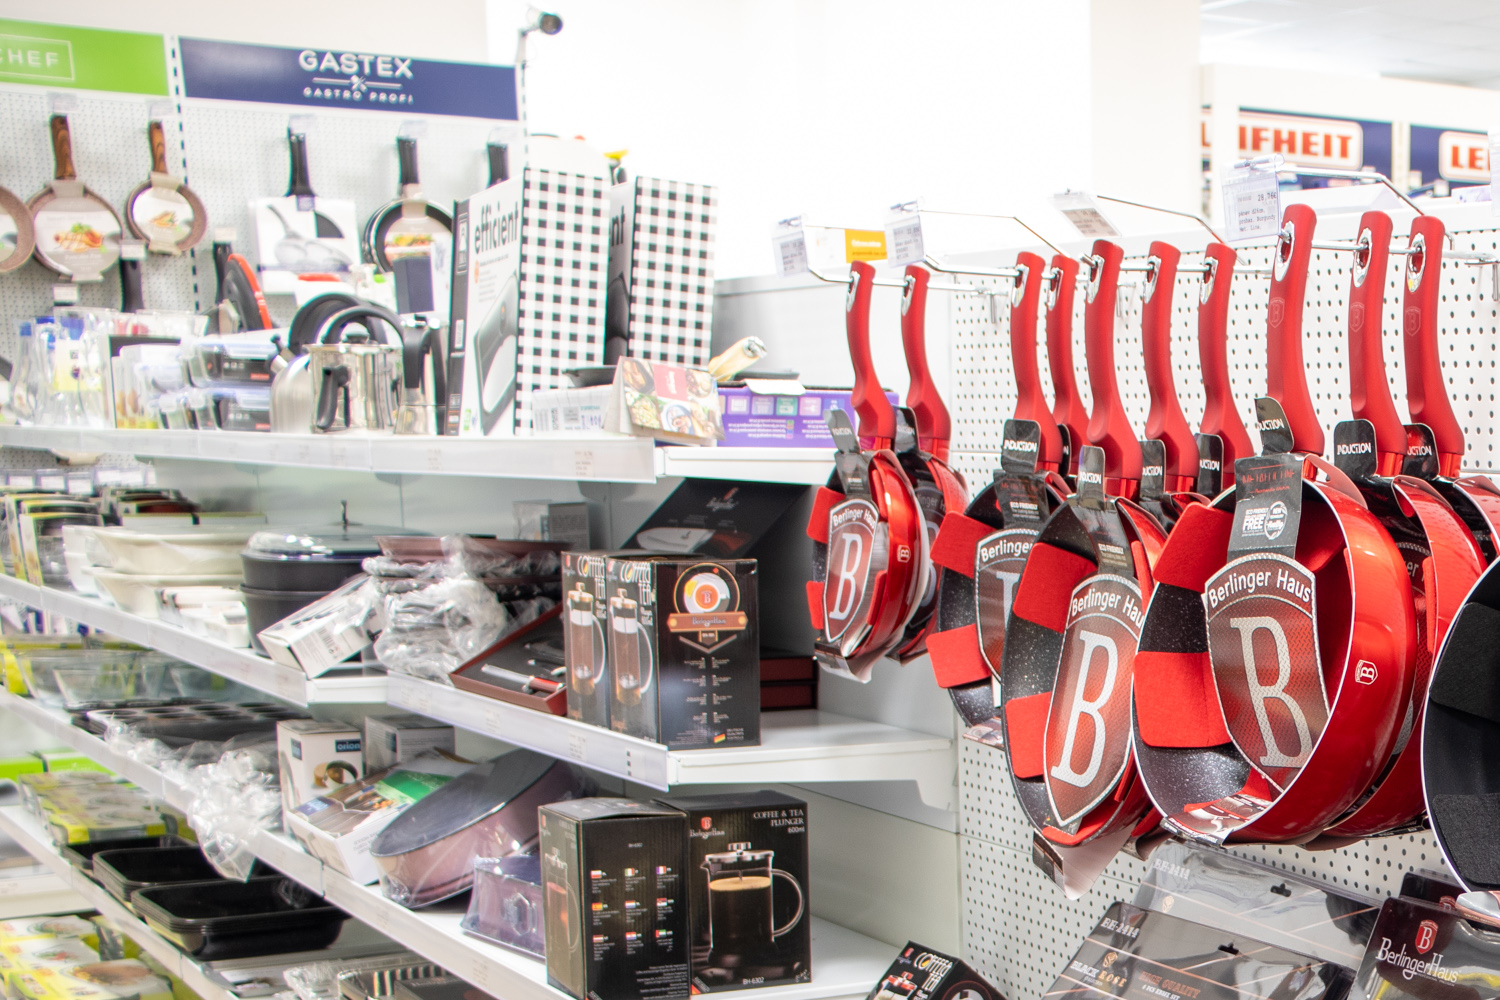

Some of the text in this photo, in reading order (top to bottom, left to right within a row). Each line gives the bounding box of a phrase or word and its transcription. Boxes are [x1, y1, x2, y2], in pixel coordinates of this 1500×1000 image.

[0, 46, 59, 67] HEF
[299, 49, 414, 79] GASTEX
[303, 87, 415, 104] GASTRO PROFI
[1201, 120, 1353, 160] LIFHEIT
[474, 201, 520, 255] efficient
[1003, 439, 1038, 453] INDUCTION
[1337, 443, 1372, 456] INDUCTION
[832, 507, 863, 528] Berlinger
[829, 533, 863, 620] B
[1208, 568, 1312, 609] Berlinger Haus
[1071, 588, 1144, 629] Berlinger Hau
[1230, 616, 1314, 768] B
[1050, 630, 1119, 788] B
[337, 741, 361, 751] orion
[753, 810, 779, 820] COFFEE
[771, 818, 804, 827] PLUNGER
[788, 826, 805, 834] 600ml
[1100, 916, 1140, 939] BH-2414
[1375, 937, 1458, 984] BerlingerHaus
[742, 976, 765, 986] BH-6302
[1069, 959, 1128, 989] BLACK ROSE
[1138, 970, 1202, 1000] HIGH QUALITY
